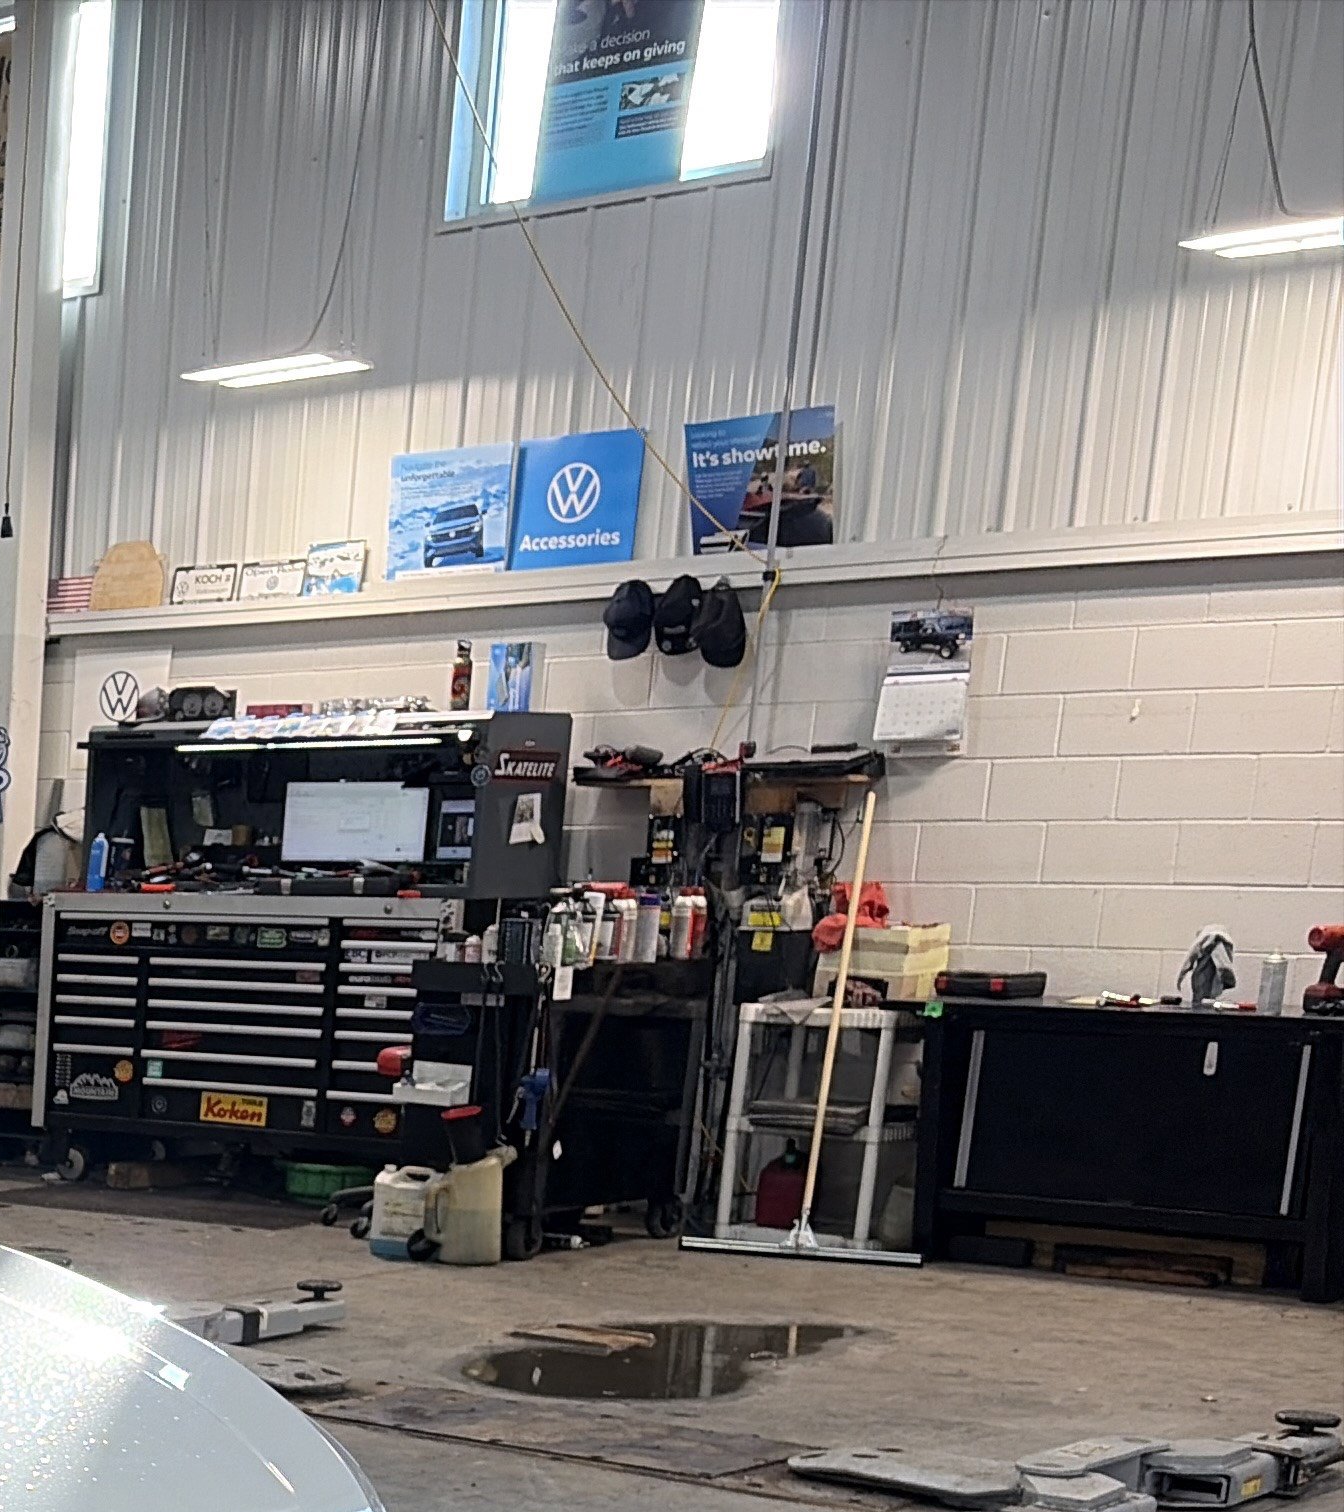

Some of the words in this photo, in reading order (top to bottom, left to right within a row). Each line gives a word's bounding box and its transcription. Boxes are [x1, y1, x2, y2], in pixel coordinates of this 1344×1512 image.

[600, 29, 650, 49] decision
[554, 60, 579, 76] that
[582, 52, 620, 71] keeps
[623, 49, 640, 62] on
[643, 40, 686, 61] giving
[692, 451, 719, 469] It's
[722, 440, 827, 464] showtme.
[519, 528, 621, 552] Accessories
[194, 574, 222, 585] KOCH
[494, 752, 556, 778] SKATELITE
[203, 1095, 263, 1123] Koken
